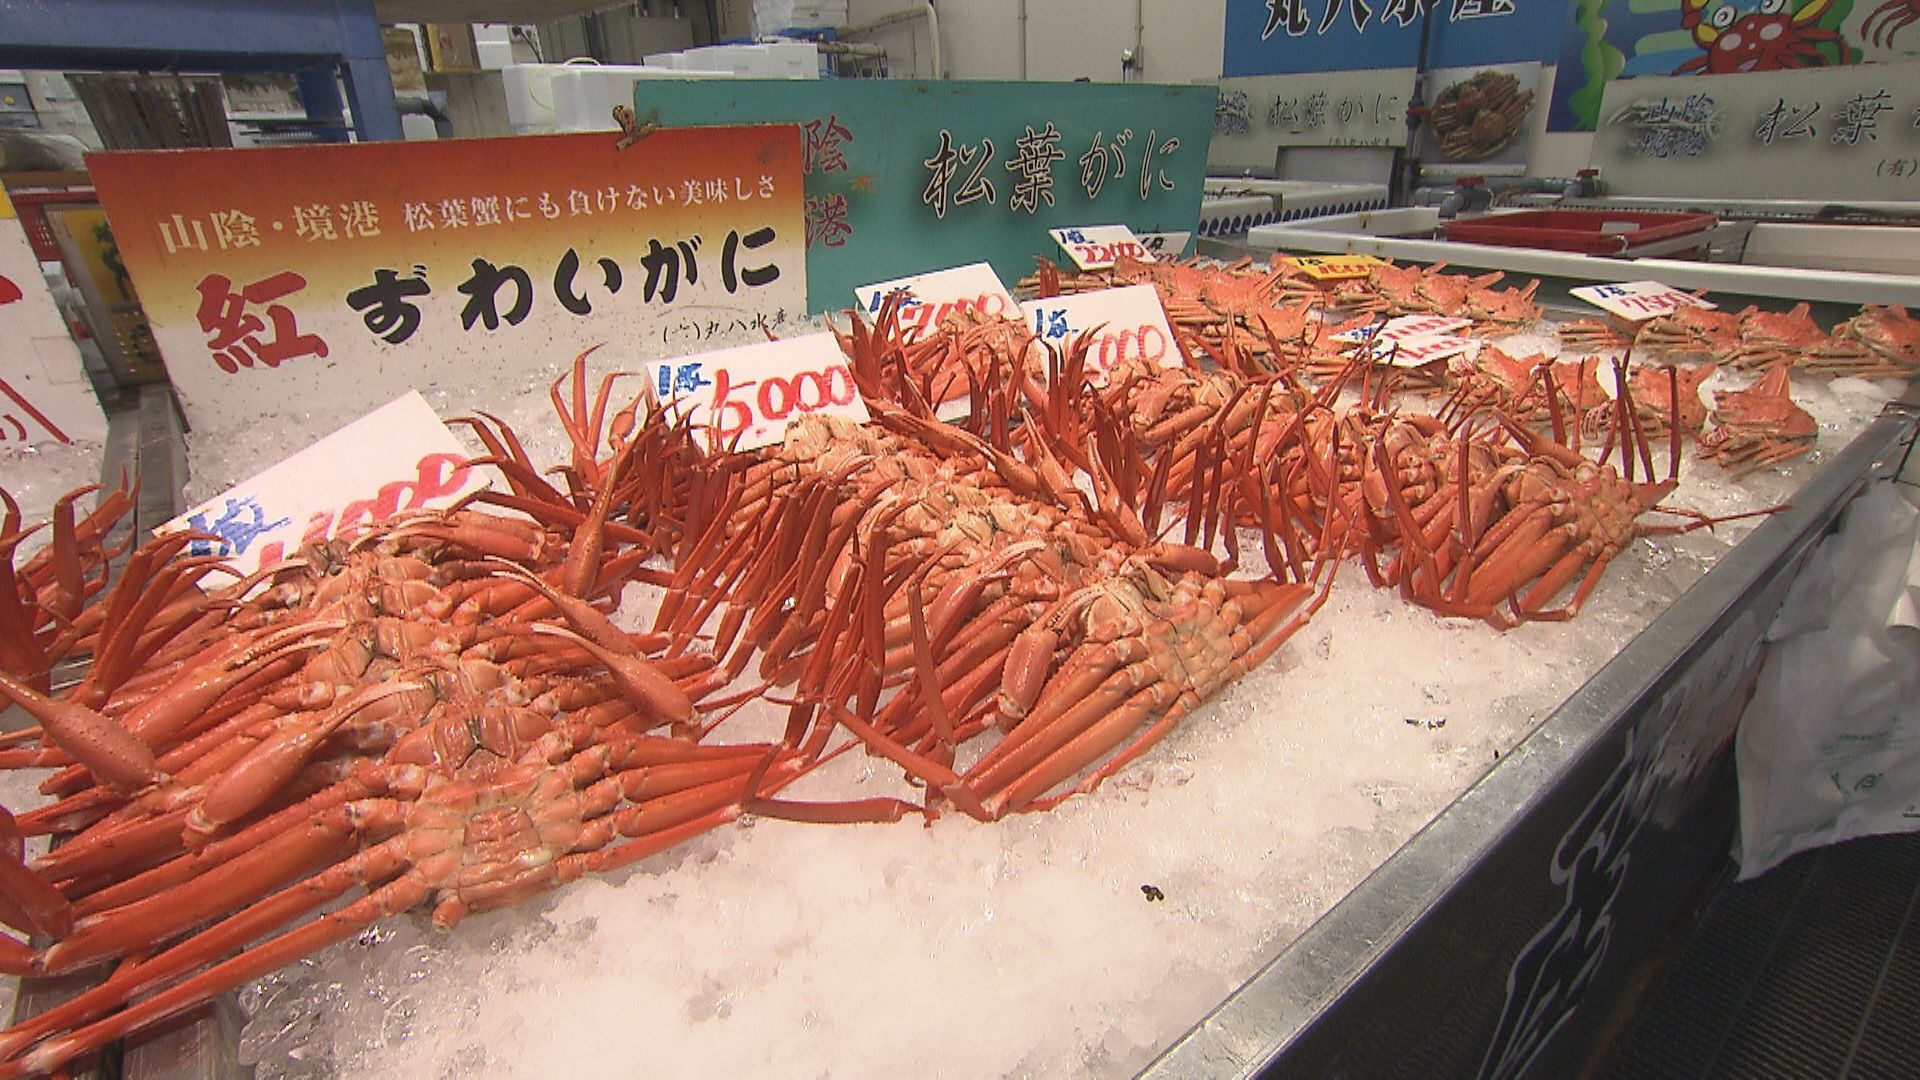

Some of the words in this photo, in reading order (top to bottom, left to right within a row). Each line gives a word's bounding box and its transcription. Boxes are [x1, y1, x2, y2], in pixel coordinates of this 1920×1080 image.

[1757, 89, 1920, 144] 松葉
[923, 121, 1182, 220] 松葉がに
[158, 200, 383, 254] 山陰・境港
[404, 174, 776, 234] 松葉蟹にも負けない美味しさ
